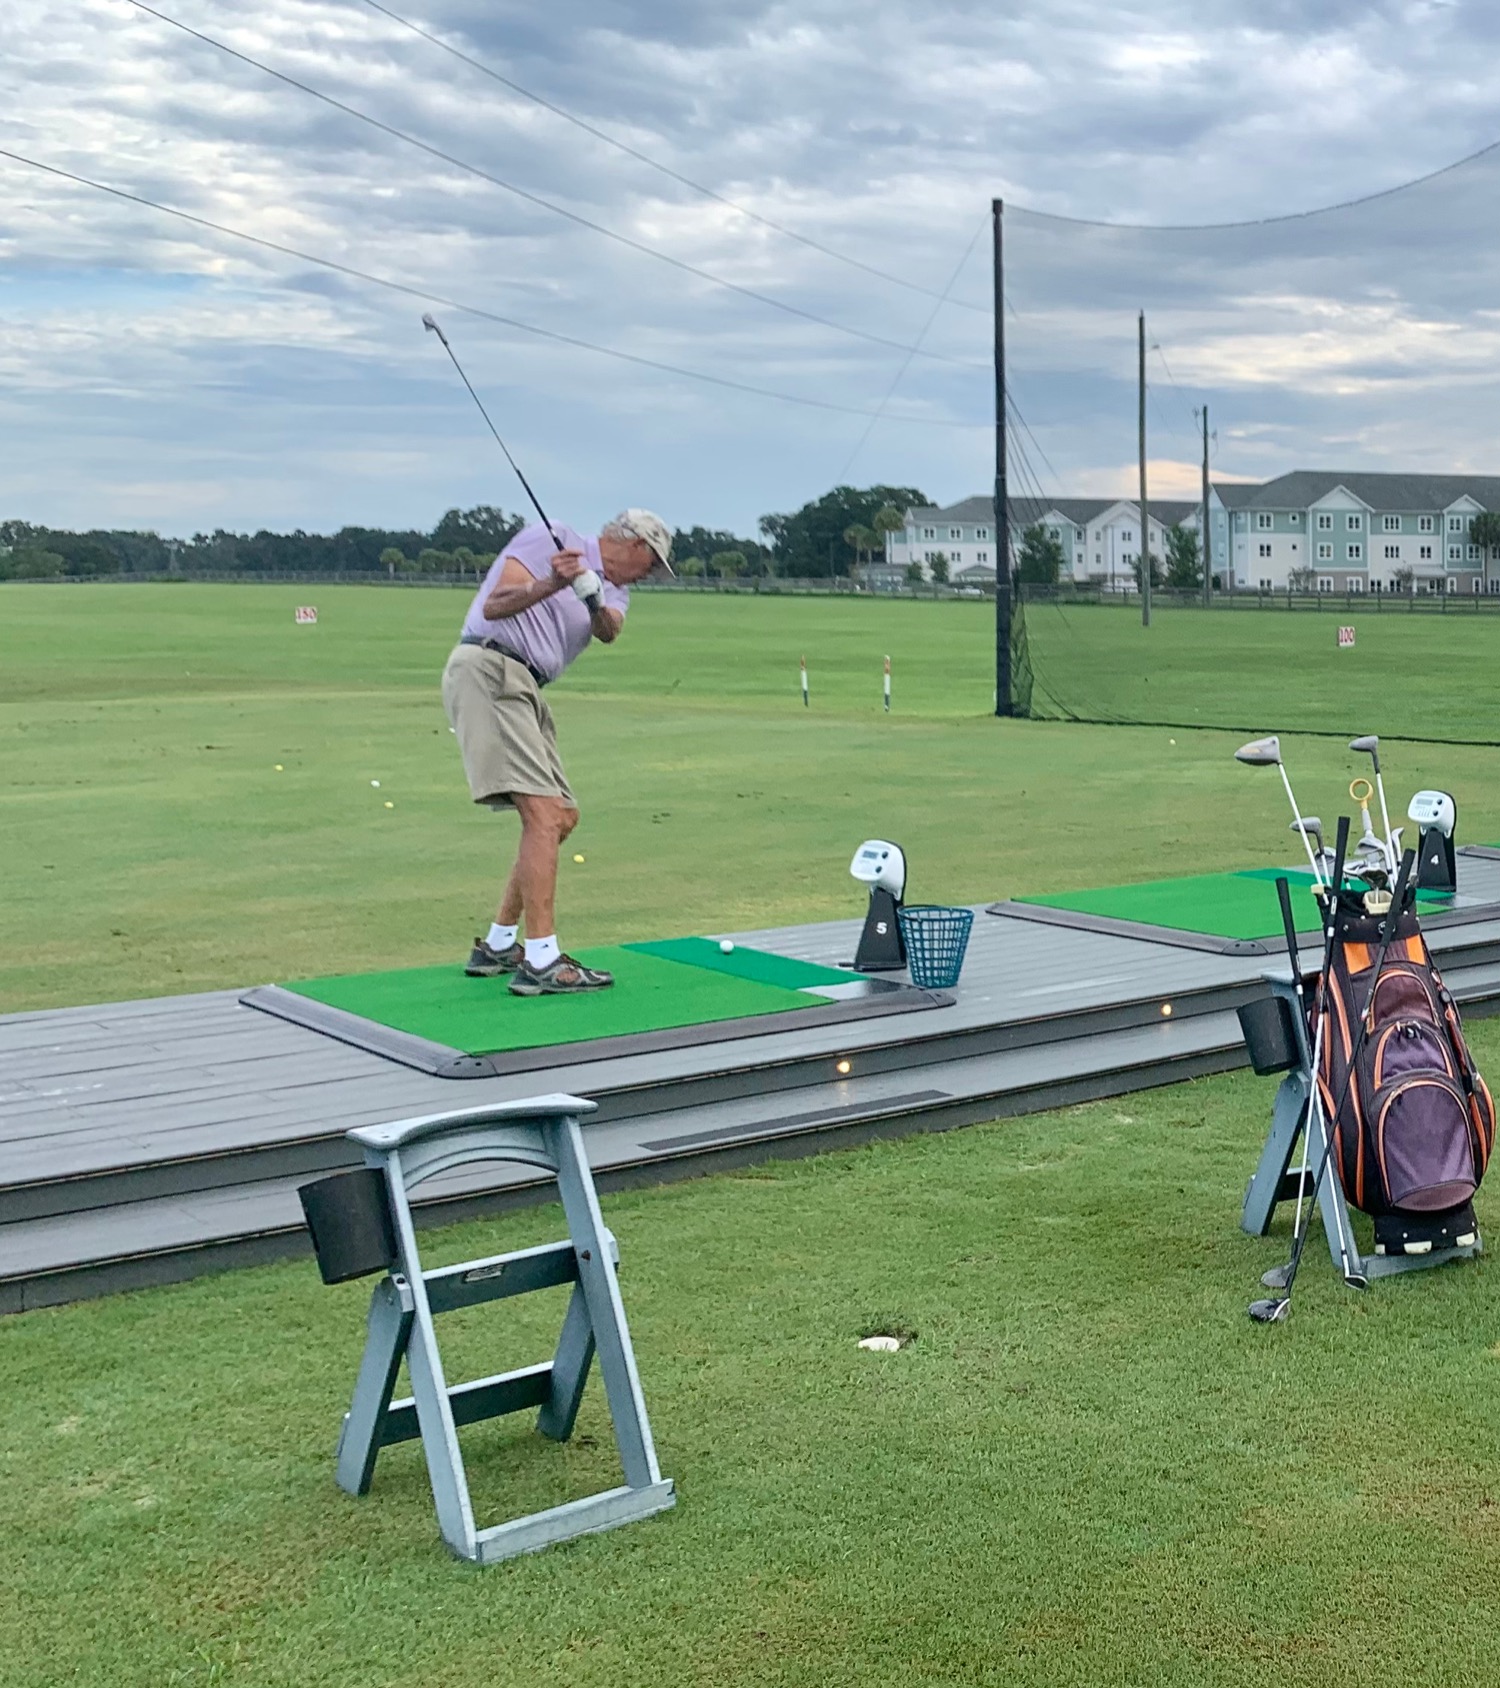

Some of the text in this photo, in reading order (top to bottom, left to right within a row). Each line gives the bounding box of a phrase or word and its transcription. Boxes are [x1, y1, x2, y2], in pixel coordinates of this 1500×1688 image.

[1340, 627, 1355, 643] 100
[1430, 854, 1439, 865] 4
[876, 922, 887, 934] 5
